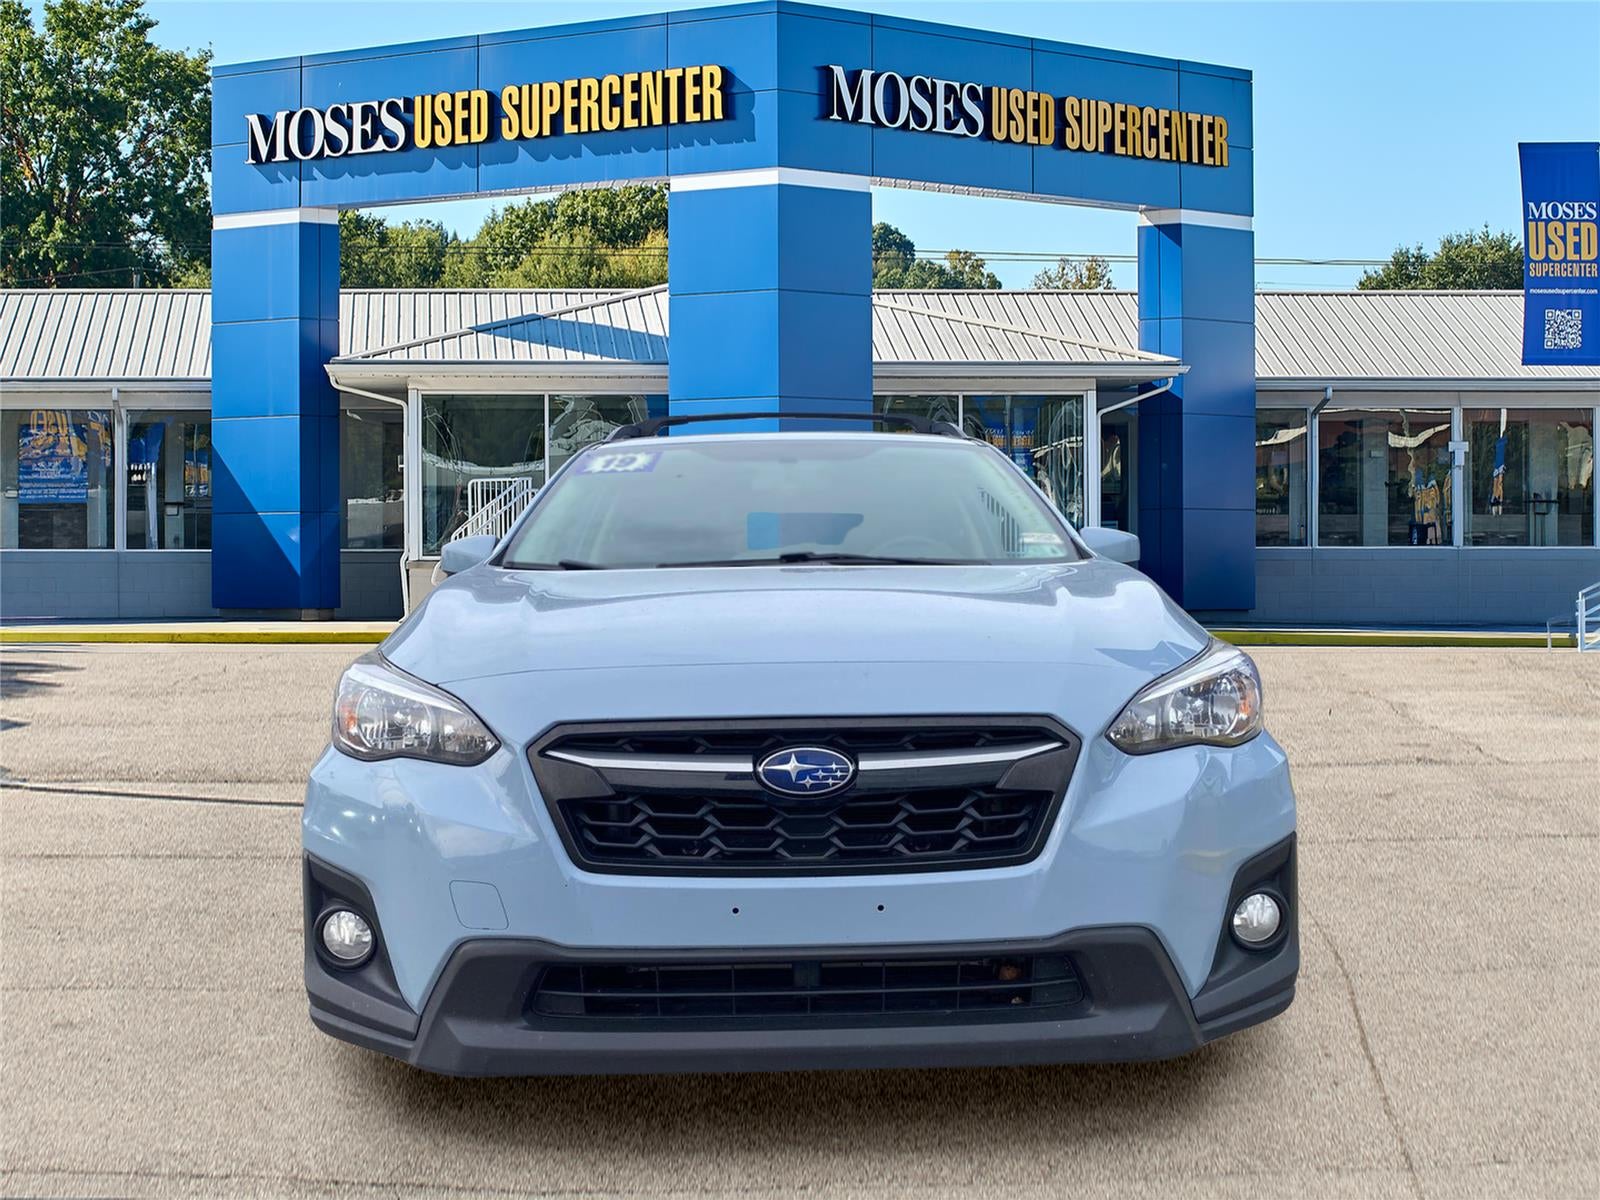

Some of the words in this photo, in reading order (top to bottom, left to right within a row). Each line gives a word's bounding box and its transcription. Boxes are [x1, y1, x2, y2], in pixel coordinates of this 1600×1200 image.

[244, 98, 407, 165] MOSES
[413, 89, 489, 149] USED
[501, 64, 724, 141] SUPERCENTER
[828, 65, 985, 138] MOSES
[992, 87, 1056, 146] USED
[1064, 96, 1230, 167] SUPERCENTER
[1528, 202, 1597, 220] MOSES
[1528, 221, 1598, 261] USED
[1529, 263, 1598, 277] SUPERCENTER
